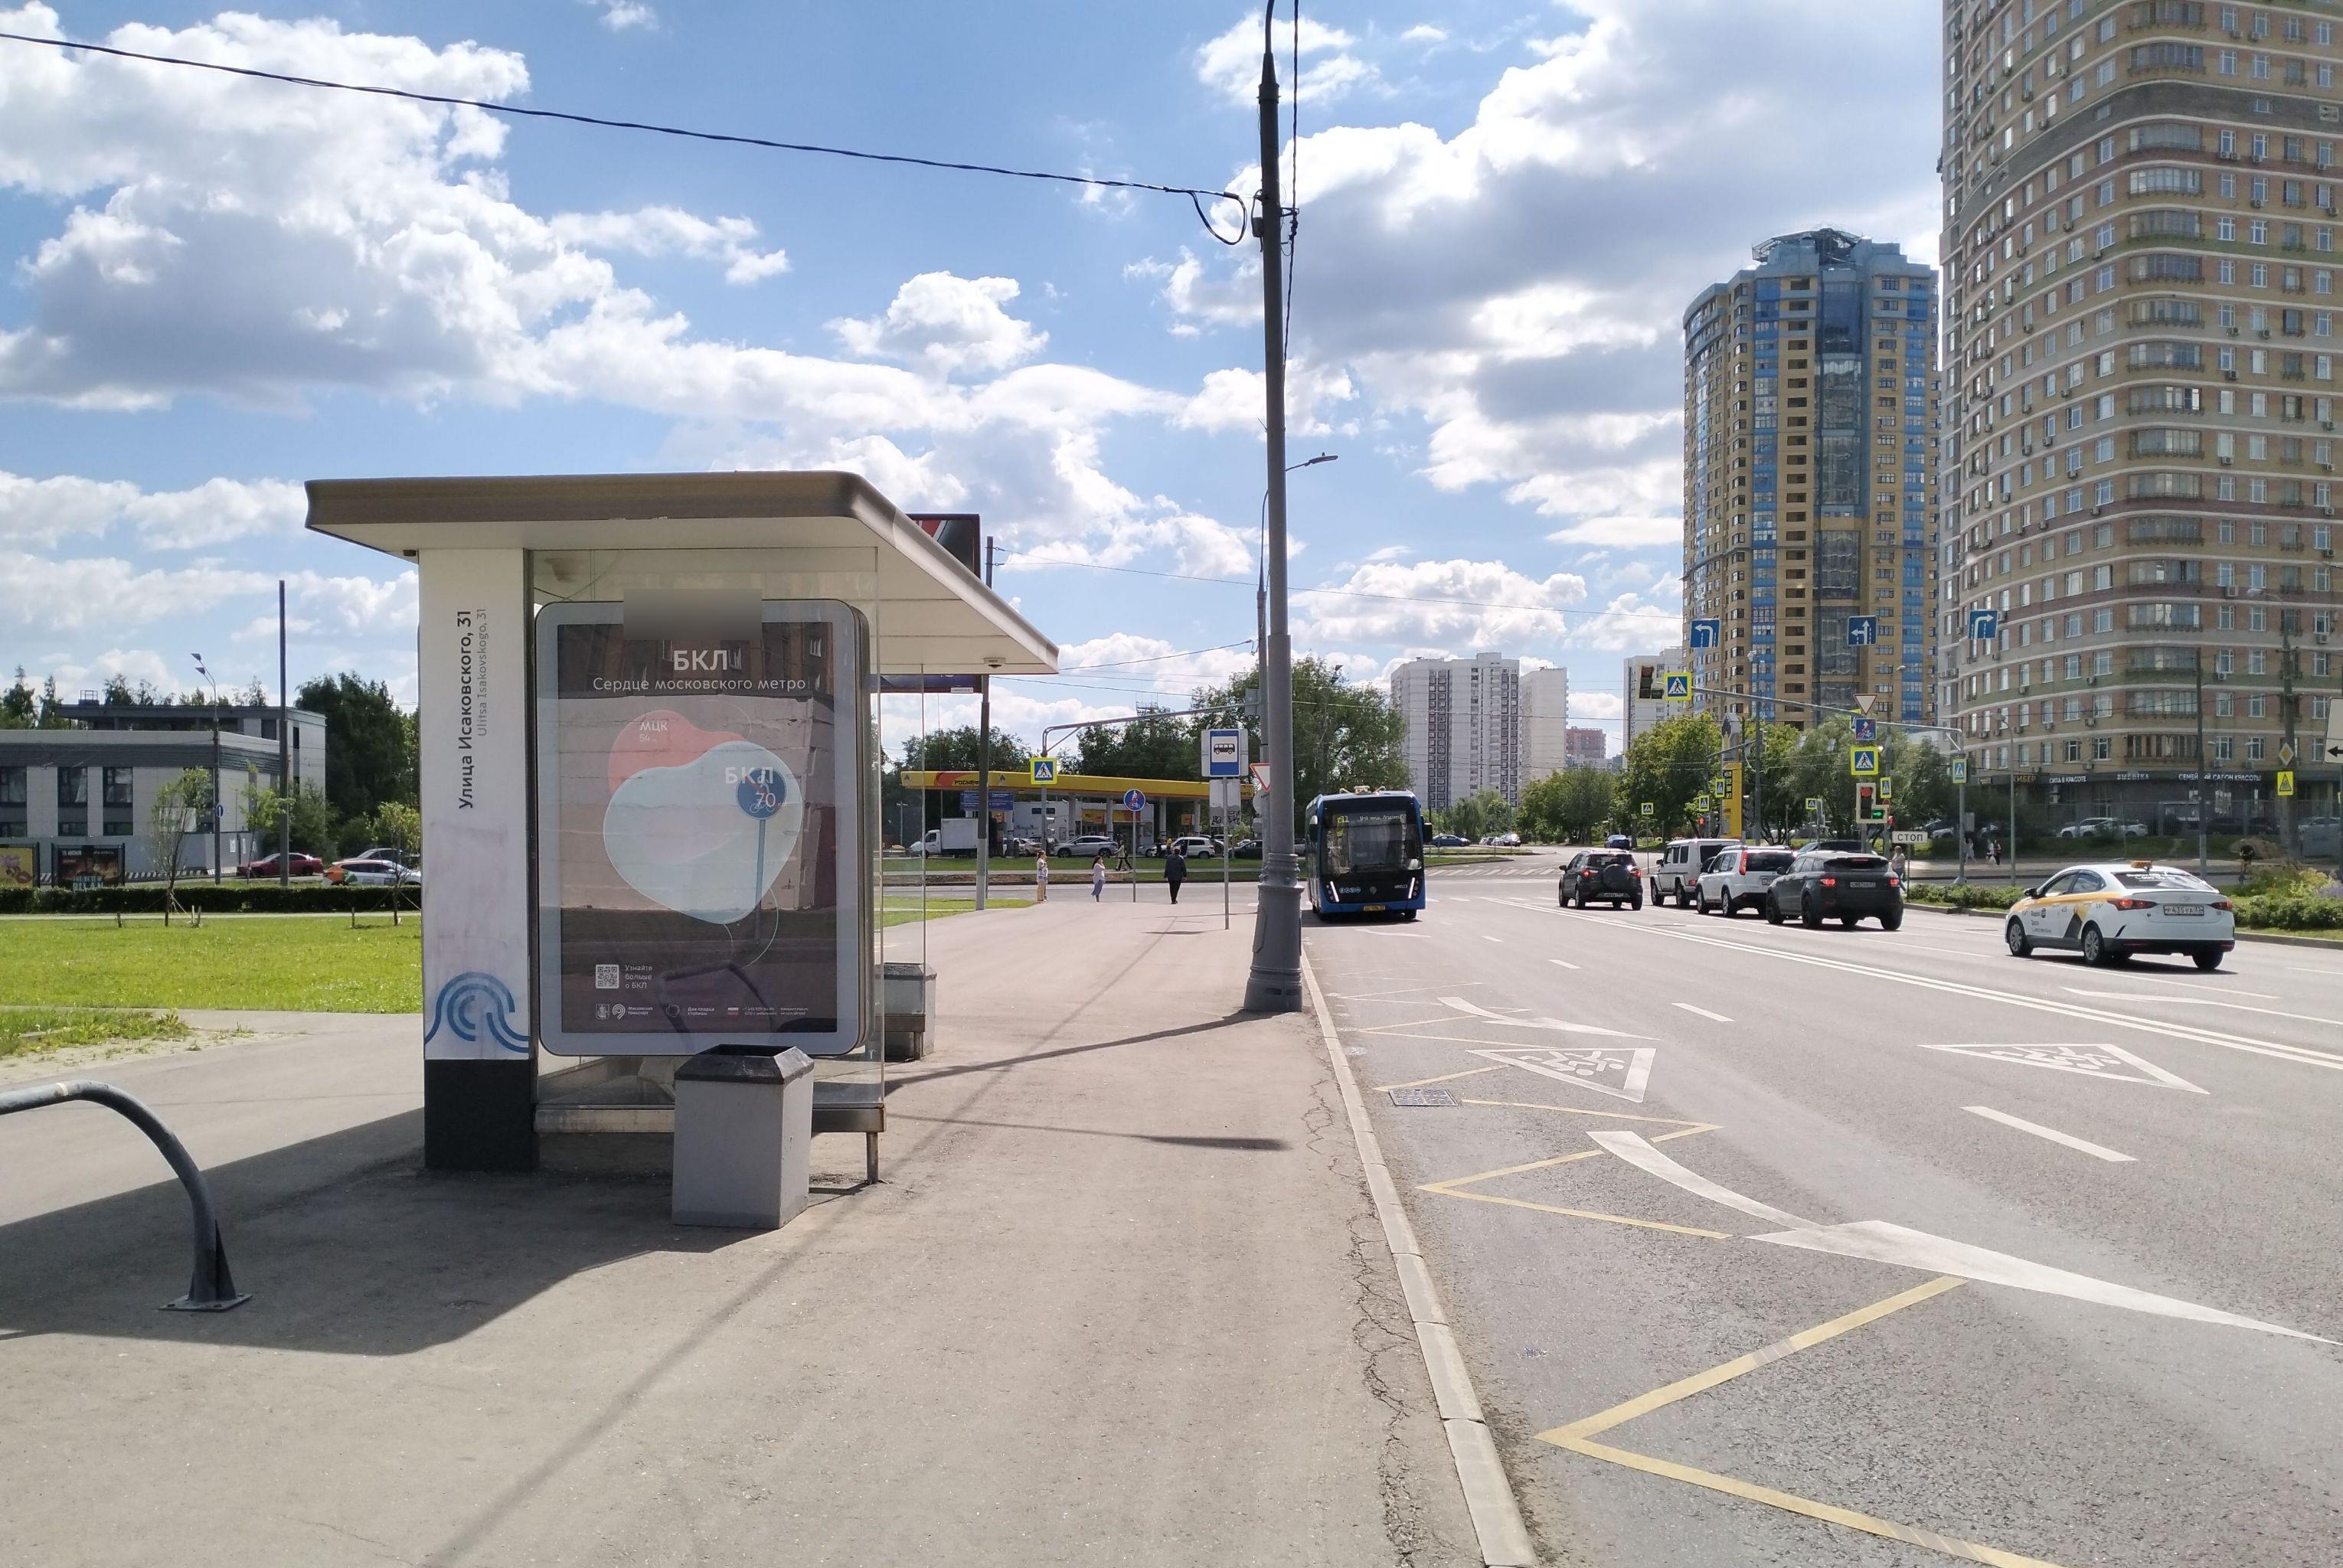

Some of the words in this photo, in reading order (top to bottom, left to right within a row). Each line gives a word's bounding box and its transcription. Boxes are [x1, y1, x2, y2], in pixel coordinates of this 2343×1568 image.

[457, 611, 472, 628] 31
[476, 608, 487, 619] 31
[476, 622, 489, 699] Isakovskogo,
[673, 649, 727, 671] БКЛ
[458, 632, 474, 750] Исаковского,
[593, 677, 649, 693] Сердце
[655, 679, 753, 690] московского
[757, 679, 806, 692] метро
[477, 701, 488, 737] Ulitsa
[639, 721, 668, 733] МЦК
[458, 754, 475, 809] Улица
[724, 766, 774, 784] БКЛ
[755, 792, 776, 808] 70
[1897, 833, 1923, 842] СТОП
